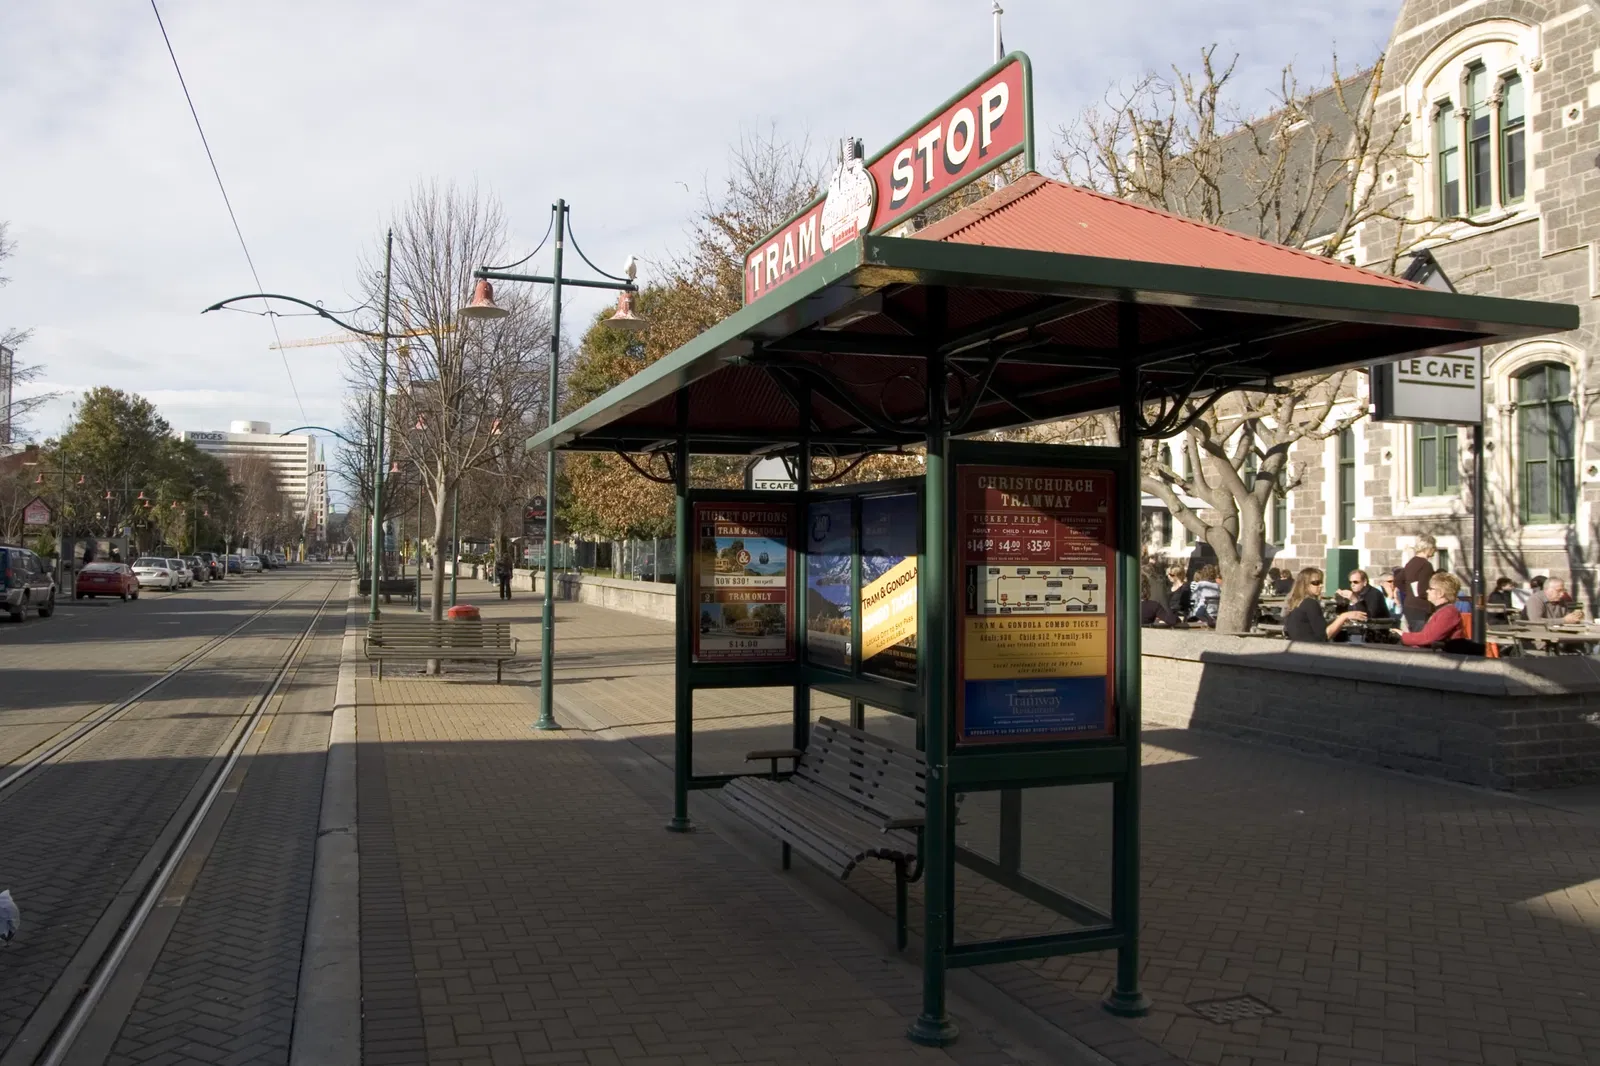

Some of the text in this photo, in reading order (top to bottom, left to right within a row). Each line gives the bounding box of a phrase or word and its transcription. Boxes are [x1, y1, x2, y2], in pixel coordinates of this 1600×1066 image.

[750, 81, 1010, 293] TRAM STOP
[1398, 360, 1475, 380] LE CAFE
[190, 432, 223, 440] RYDGES
[769, 482, 796, 490] CAFE
[977, 476, 1094, 493] CHRISTCHURCH
[1001, 493, 1072, 509] TRAMWAY
[699, 510, 788, 523] TICKET OPTIONS
[972, 515, 1008, 523] TICKET
[717, 526, 740, 535] TRAM
[740, 527, 748, 535] &
[998, 539, 1021, 552] $4.00
[1027, 540, 1051, 553] $35.00
[739, 551, 749, 564] &
[862, 567, 918, 610] TRAM & GONDOLA
[728, 592, 772, 601] TRAM ONLY
[973, 621, 995, 629] TRAM
[1007, 621, 1042, 629] GONDOLA
[1045, 620, 1070, 628] COMBO
[1073, 620, 1099, 628] TICKET
[728, 640, 758, 648] $14.00
[1004, 693, 1064, 708] Tramway
